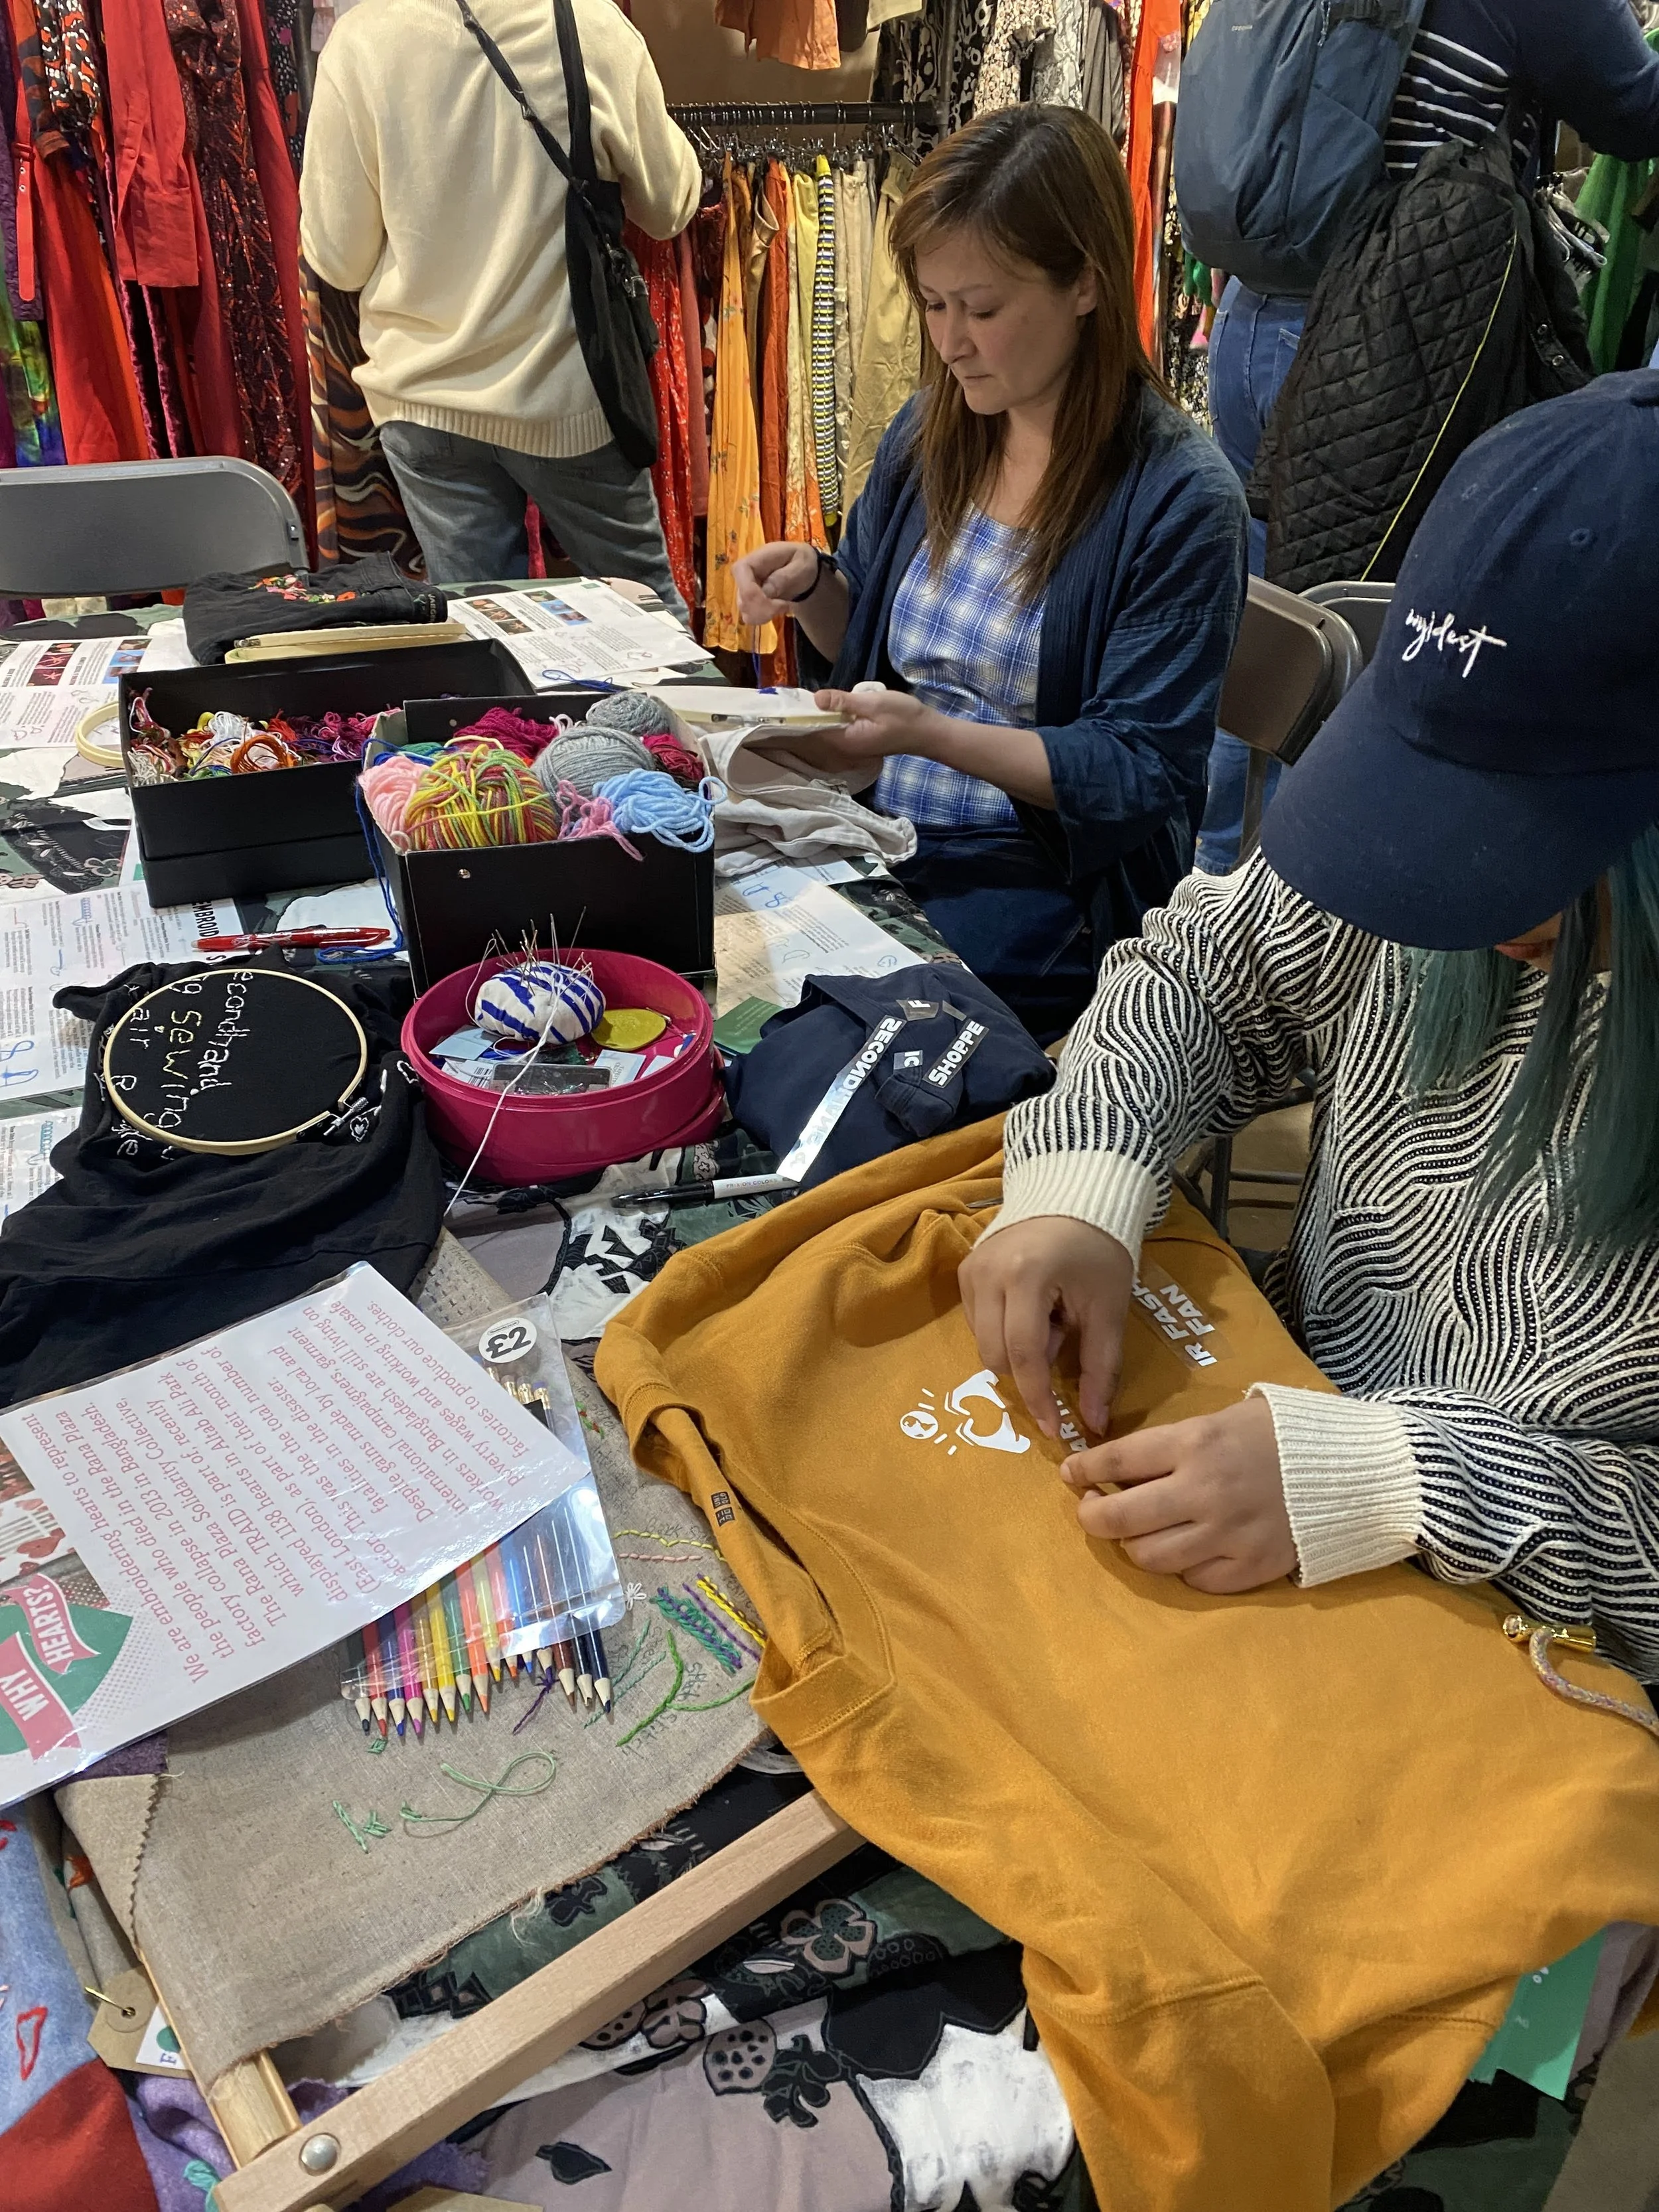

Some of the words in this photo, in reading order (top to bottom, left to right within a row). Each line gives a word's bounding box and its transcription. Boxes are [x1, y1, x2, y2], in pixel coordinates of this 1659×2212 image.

[191, 901, 219, 937] EMBROID
[196, 971, 253, 1090] econdhand
[302, 1306, 320, 1321] on
[328, 1300, 366, 1334] unsafe
[367, 1300, 406, 1338] clothes.
[1131, 1278, 1190, 1340] FASH
[1159, 1284, 1216, 1336] FAN
[287, 1327, 336, 1369] garment
[313, 1318, 349, 1353] living
[364, 1333, 380, 1348] in
[401, 1337, 425, 1356] our
[486, 1326, 532, 1359] £2
[175, 1359, 198, 1371] of
[200, 1346, 222, 1359] of
[267, 1345, 297, 1367] and
[339, 1349, 369, 1371] still
[374, 1343, 420, 1388] working
[157, 1372, 188, 1400] Park
[191, 1372, 231, 1411] month
[216, 1360, 260, 1404] number
[287, 1366, 321, 1397] local
[365, 1370, 386, 1389] are
[421, 1355, 472, 1397] produce
[177, 1398, 203, 1417] Ali
[267, 1376, 311, 1422] disaster.
[315, 1394, 334, 1413] by
[330, 1368, 397, 1439] campaigners,
[412, 1386, 443, 1409] and
[465, 1396, 480, 1410] to
[55, 1410, 85, 1443] Plaza
[115, 1397, 165, 1460] Collective,
[146, 1400, 190, 1447] recently
[224, 1411, 255, 1441] their
[250, 1404, 283, 1432] total
[306, 1423, 329, 1444] the
[330, 1409, 364, 1442] made
[380, 1388, 446, 1453] Bangladesh
[439, 1408, 474, 1443] wages
[477, 1408, 530, 1459] factories
[21, 1413, 69, 1470] represent
[80, 1402, 140, 1474] Bangladesh.
[194, 1419, 230, 1451] Altab
[243, 1441, 267, 1455] of
[278, 1431, 301, 1454] the
[78, 1443, 108, 1477] Rana
[180, 1446, 204, 1464] of,
[224, 1451, 242, 1469] in
[297, 1453, 320, 1477] the
[325, 1443, 342, 1461] in
[359, 1441, 397, 1473] gains
[442, 1448, 459, 1466] in
[62, 1471, 80, 1487] to
[133, 1472, 152, 1489] in
[197, 1465, 232, 1493] part
[261, 1455, 295, 1483] part
[388, 1438, 469, 1518] international
[100, 1476, 123, 1499] the
[158, 1461, 211, 1523] Solidarity
[220, 1493, 237, 1509] is
[236, 1467, 275, 1512] hearts
[284, 1483, 303, 1498] as
[315, 1475, 339, 1502] was
[337, 1458, 389, 1514] fatalities
[388, 1473, 435, 1523] Despite
[455, 1463, 504, 1512] workers
[72, 1487, 109, 1533] hearts
[117, 1499, 136, 1516] in
[140, 1489, 174, 1520] 2013
[337, 1501, 366, 1534] This
[122, 1516, 157, 1546] died
[168, 1519, 186, 1538] in
[206, 1521, 238, 1560] Plaza
[227, 1509, 271, 1555] TRAID
[264, 1509, 297, 1540] 1138
[295, 1497, 351, 1560] London),
[100, 1529, 174, 1625] embroidering
[151, 1549, 179, 1581] who
[180, 1537, 226, 1592] collapse
[232, 1557, 265, 1597] Rana
[263, 1552, 305, 1597] which
[286, 1537, 348, 1601] displayed
[344, 1556, 382, 1594] (East
[173, 1581, 222, 1630] people
[220, 1594, 266, 1647] factory
[259, 1594, 287, 1627] The
[23, 1584, 75, 1666] HEARTS?
[167, 1627, 192, 1652] are
[209, 1631, 236, 1659] the
[183, 1653, 209, 1684] We
[0, 1668, 50, 1722] WHY
